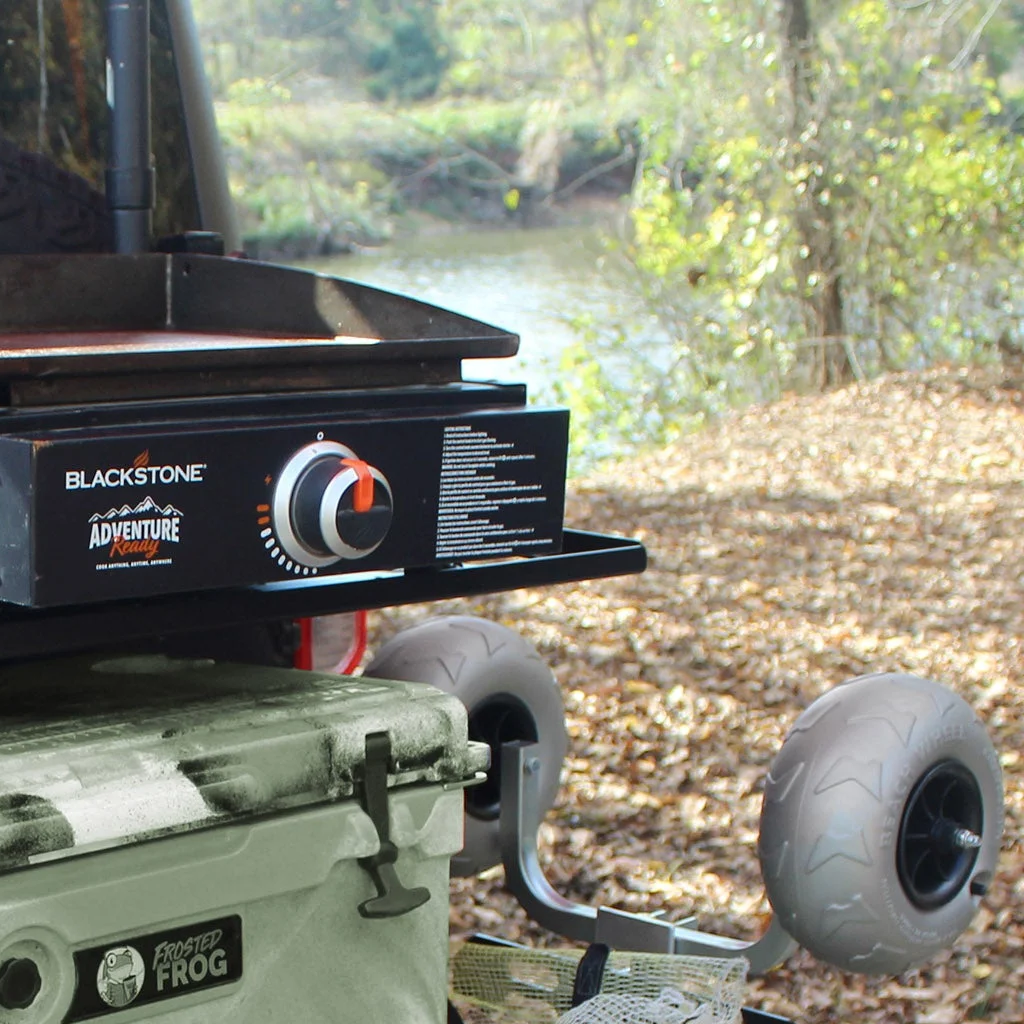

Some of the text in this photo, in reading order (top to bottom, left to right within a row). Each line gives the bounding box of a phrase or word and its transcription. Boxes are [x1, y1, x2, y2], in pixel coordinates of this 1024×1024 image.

[65, 463, 205, 490] BLACKSTONE
[89, 517, 180, 549] ADVENTURE
[109, 535, 160, 559] Ready
[152, 929, 223, 971] FROSTED
[156, 949, 228, 992] FROG
